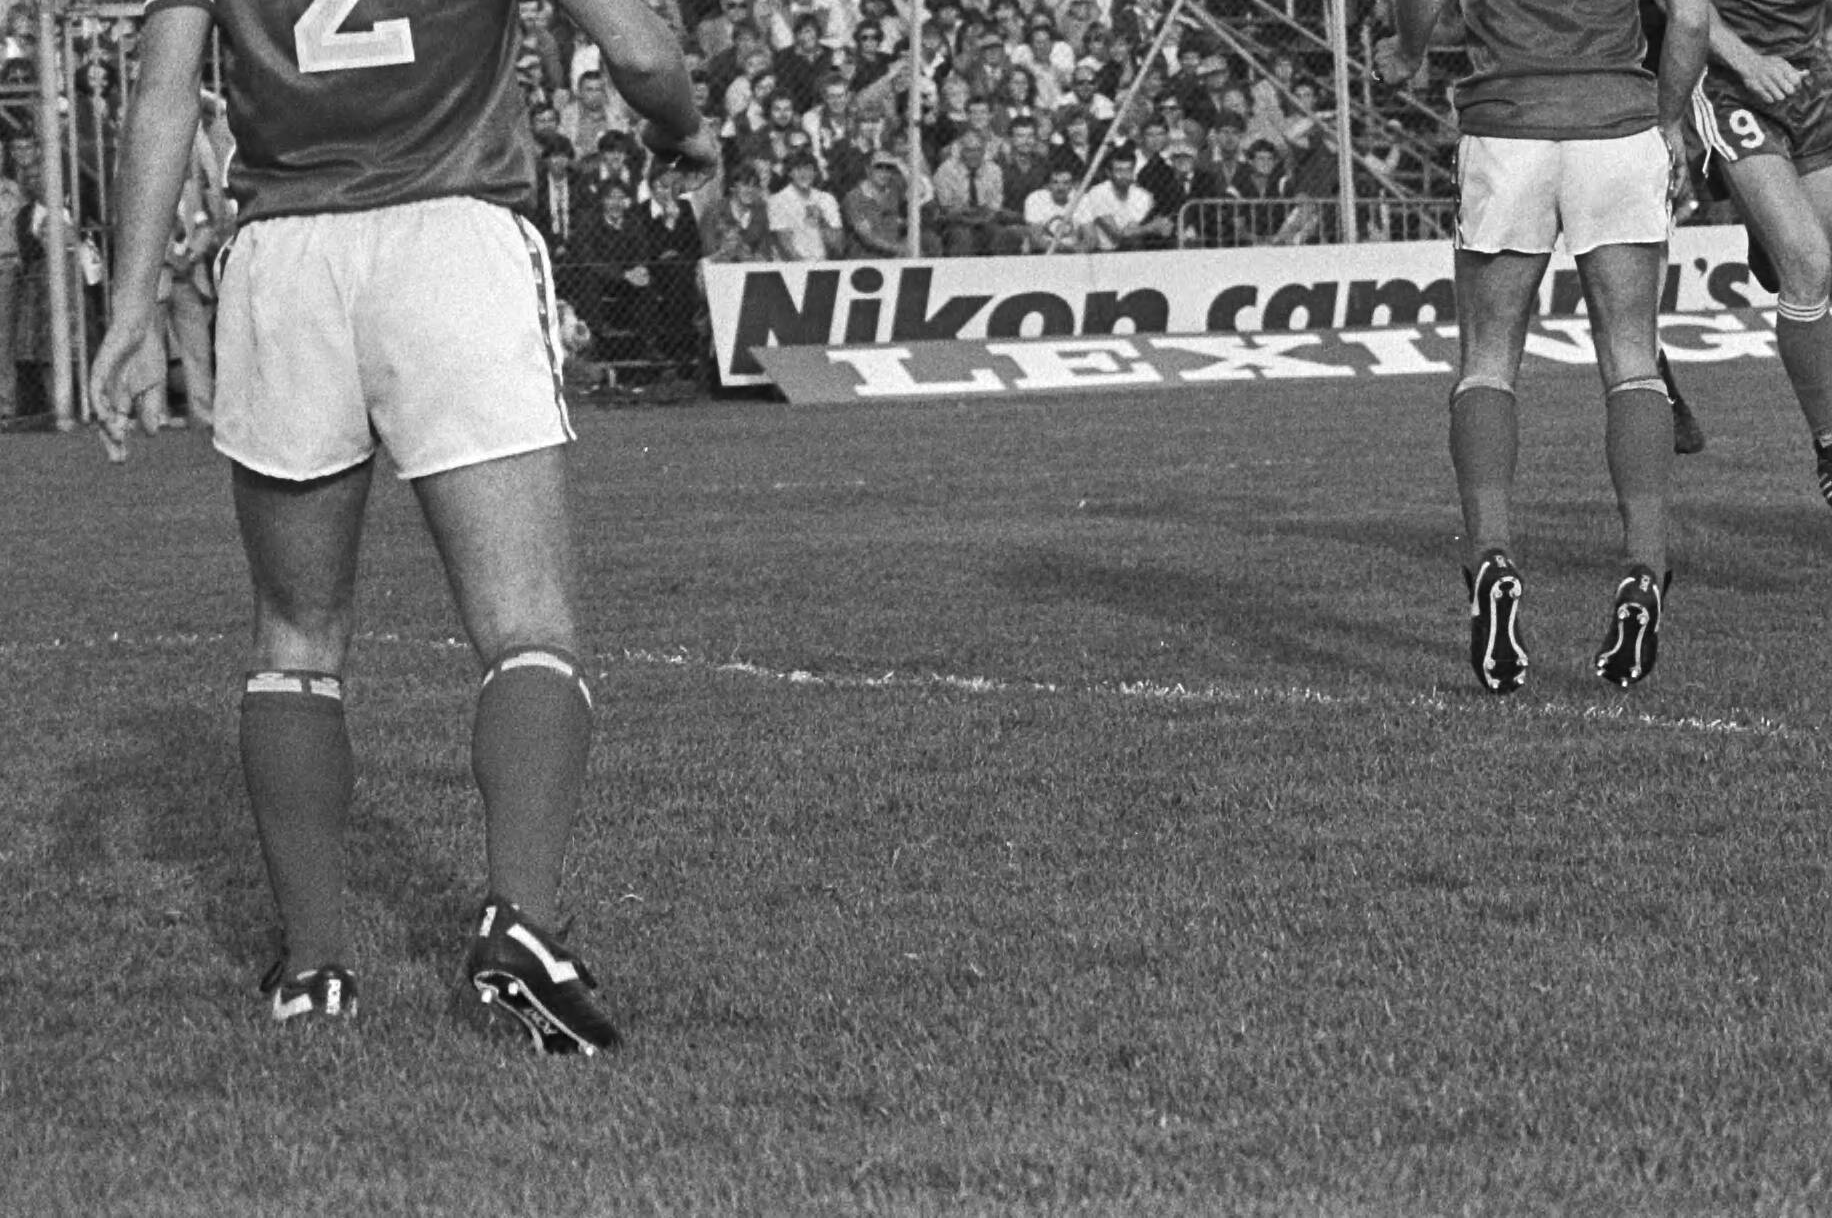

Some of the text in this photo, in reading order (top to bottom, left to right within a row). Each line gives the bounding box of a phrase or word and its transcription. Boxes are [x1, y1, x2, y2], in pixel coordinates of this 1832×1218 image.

[1729, 108, 1766, 149] 9
[729, 266, 1169, 375] Nikon
[1206, 256, 1750, 336] cam's
